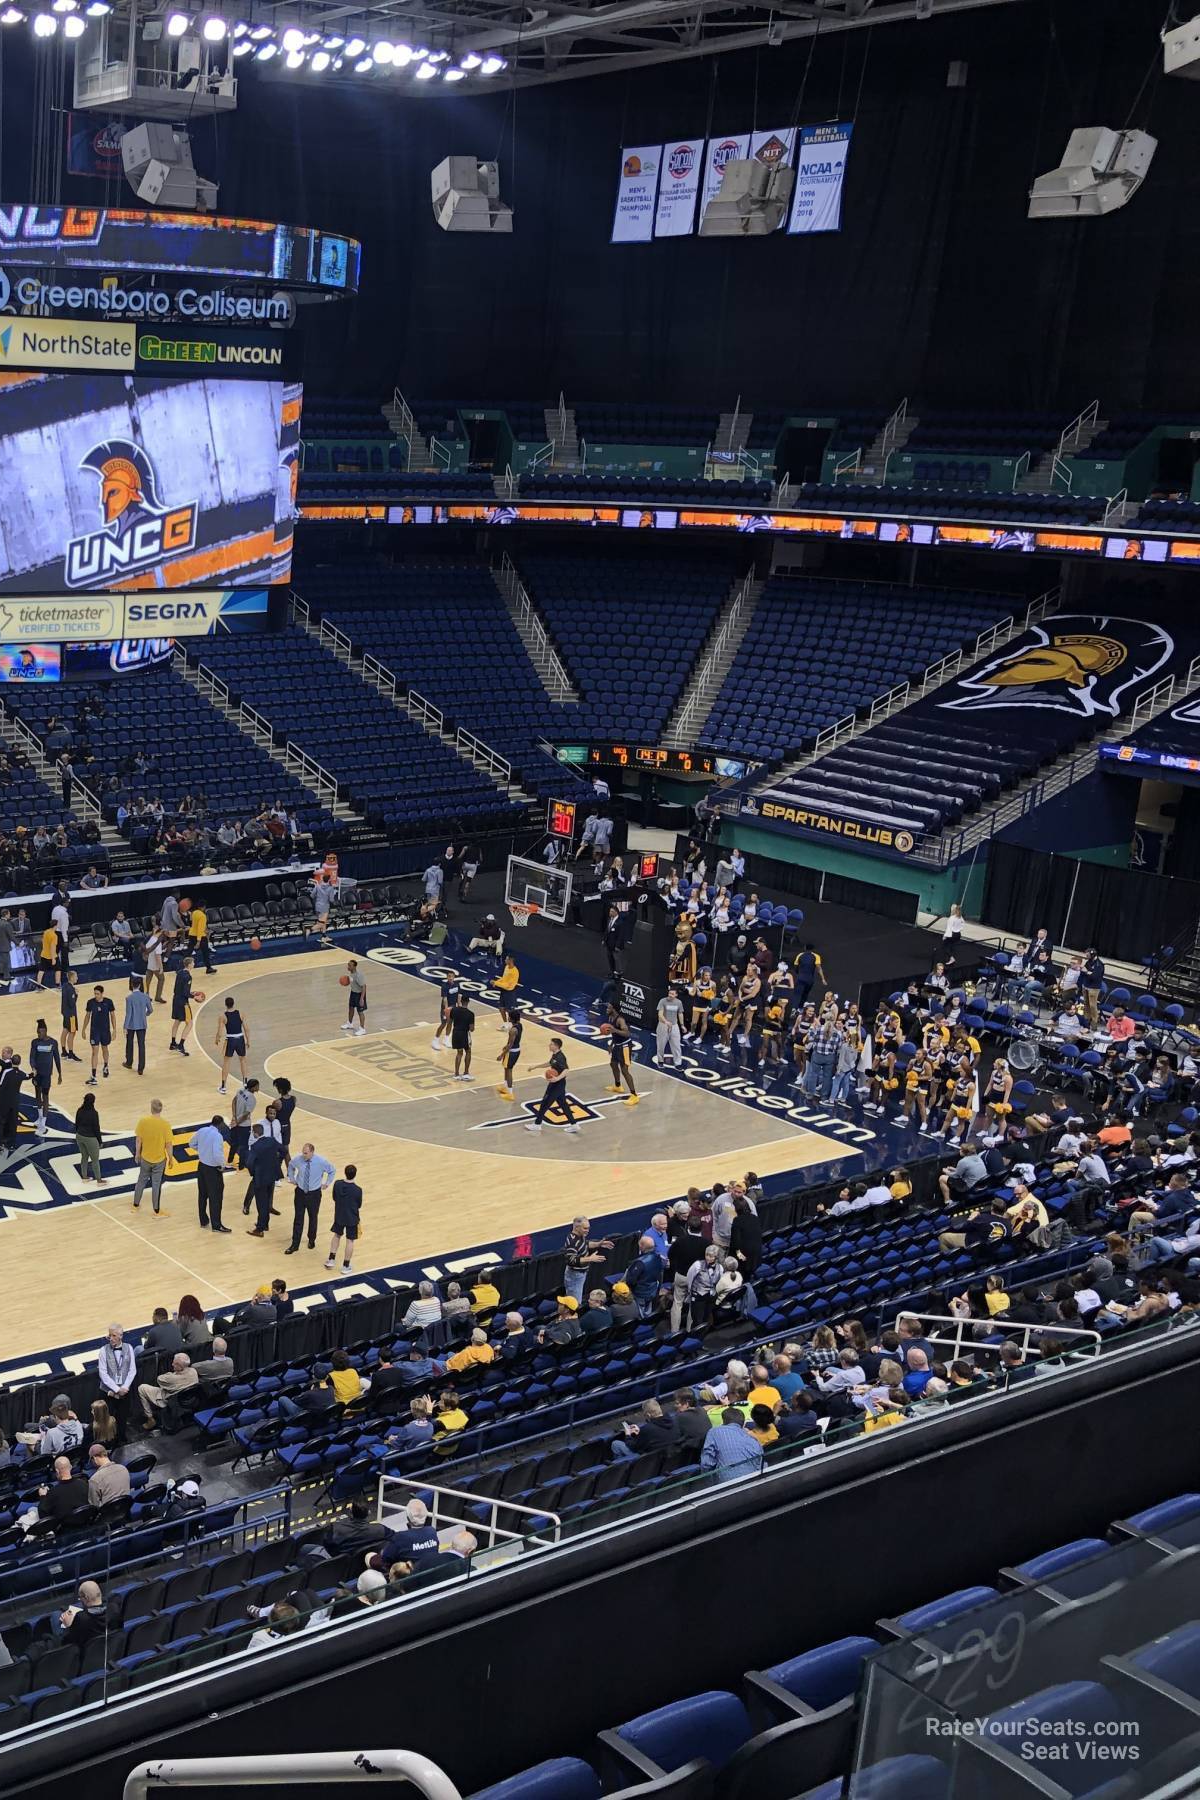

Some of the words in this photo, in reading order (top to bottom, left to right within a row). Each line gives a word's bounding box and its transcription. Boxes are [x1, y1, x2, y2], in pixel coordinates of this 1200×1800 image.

[804, 132, 848, 143] BASKETBALL
[815, 126, 838, 134] MEN'S
[763, 148, 782, 157] NIT
[801, 162, 832, 175] NCAA
[17, 276, 169, 314] Greensboro
[178, 288, 288, 320] Coliseum
[22, 332, 132, 357] NorthState
[139, 335, 216, 364] GREEN
[217, 345, 282, 365] LINCOLN
[67, 505, 195, 585] UNCG
[19, 606, 104, 622] ticketmaster
[128, 603, 208, 621] SEGRA
[18, 624, 60, 633] VERIFIED
[63, 622, 100, 631] TICKETS
[554, 814, 571, 834] 30
[762, 803, 842, 833] SPARTAN
[844, 823, 893, 846] CLUB
[623, 982, 645, 1000] TFA
[412, 1539, 437, 1551] MetLife
